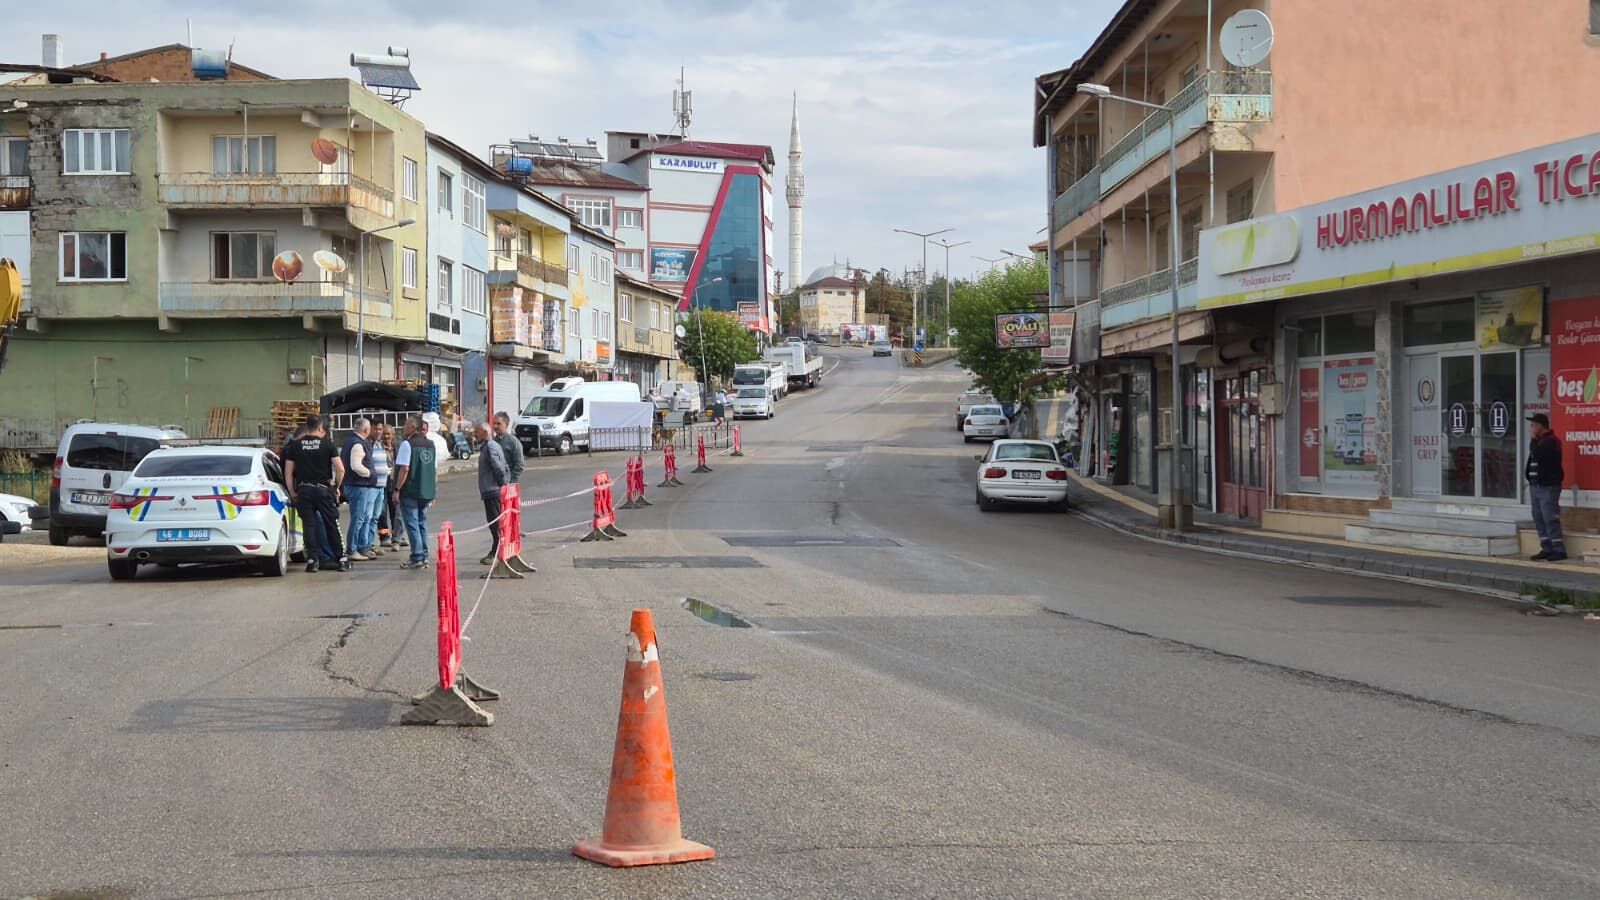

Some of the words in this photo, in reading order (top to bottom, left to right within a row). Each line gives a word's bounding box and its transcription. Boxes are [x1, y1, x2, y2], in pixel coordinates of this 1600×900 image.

[660, 159, 718, 170] KARABULUT
[1317, 171, 1517, 248] HURMANLILAR
[1557, 375, 1584, 402] beş
